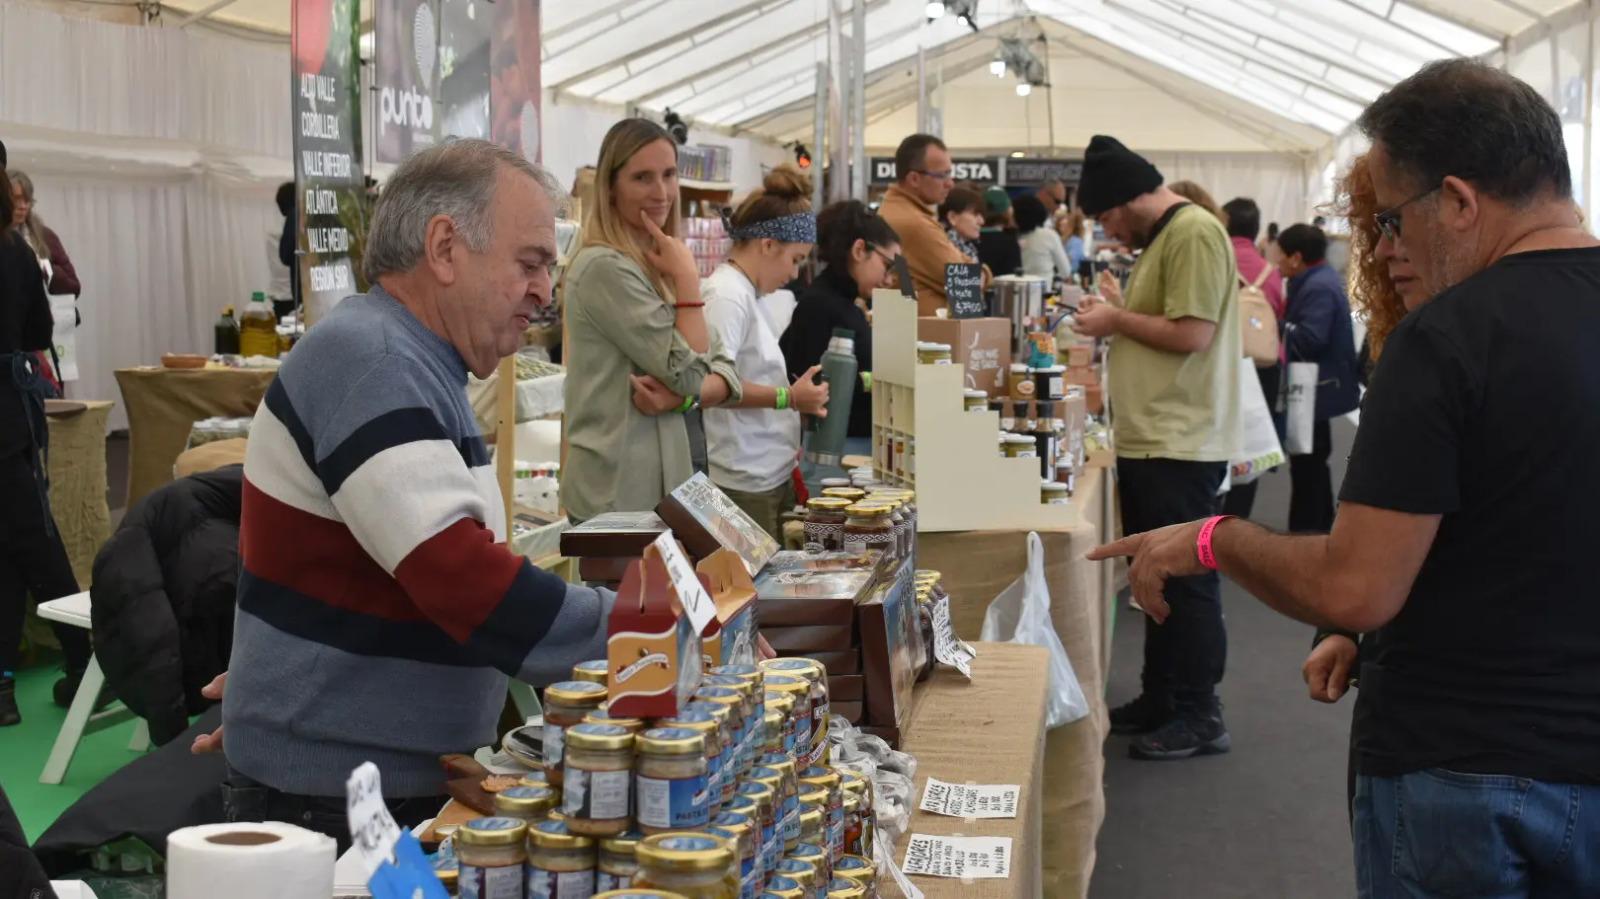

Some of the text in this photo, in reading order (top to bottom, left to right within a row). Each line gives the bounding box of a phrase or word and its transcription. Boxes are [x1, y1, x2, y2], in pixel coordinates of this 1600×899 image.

[316, 74, 336, 102] VALLE
[302, 111, 340, 140] CORDILLERA
[380, 86, 433, 137] punto
[302, 150, 352, 178] VALLE INFERIOR
[305, 184, 339, 215] ATLÁNTICA
[307, 227, 349, 253] VALLE MEDIO
[310, 261, 350, 291] REGIÓN SUR
